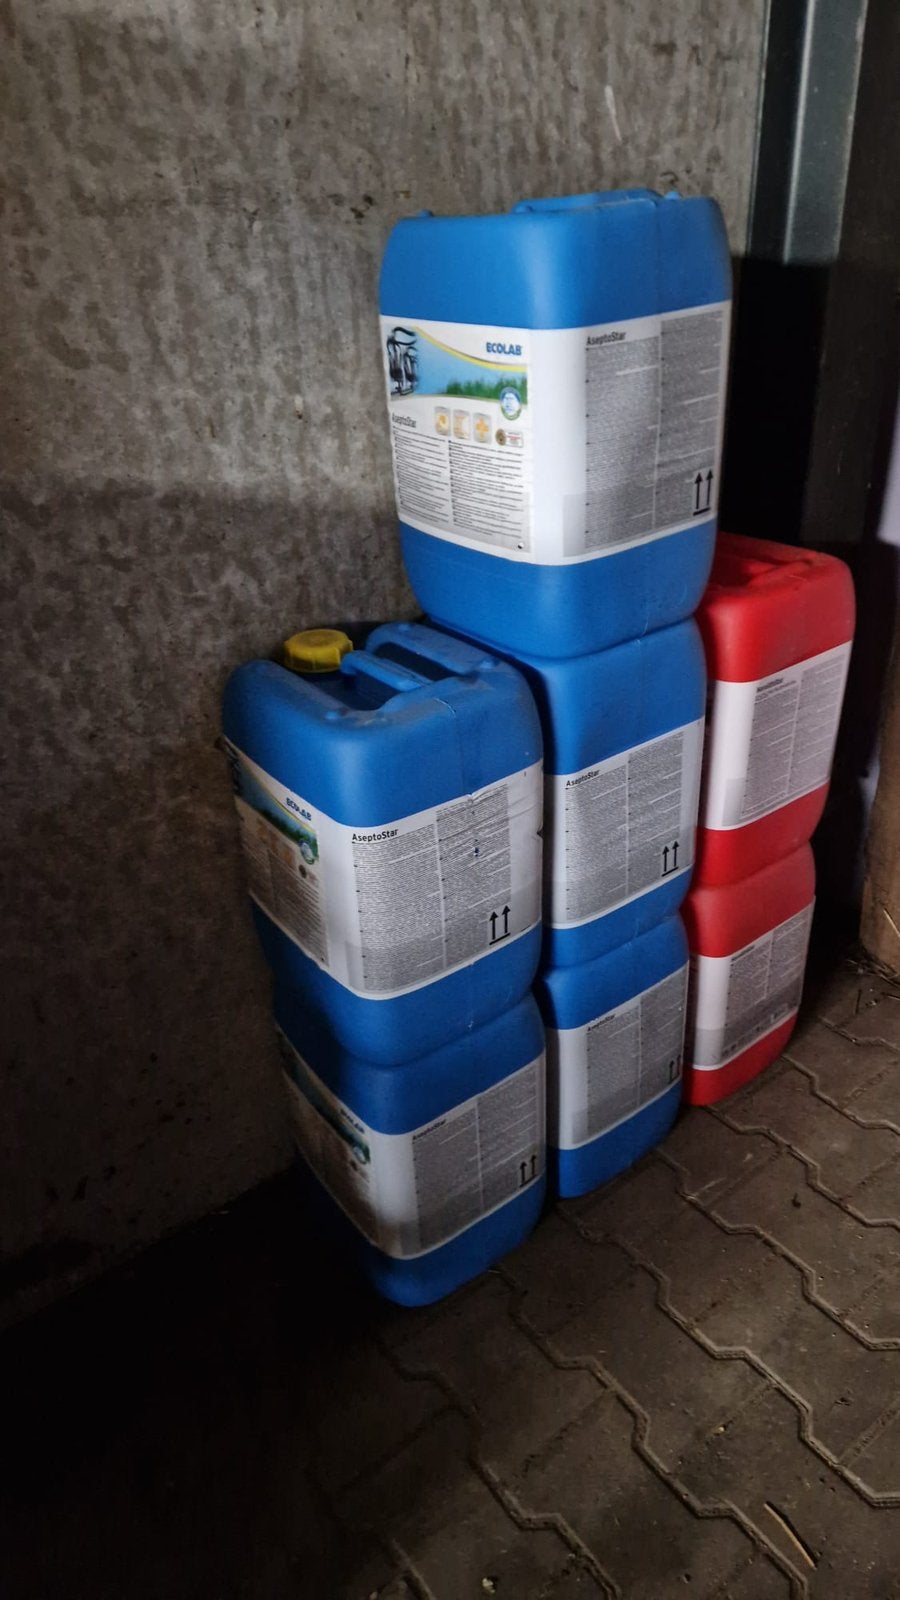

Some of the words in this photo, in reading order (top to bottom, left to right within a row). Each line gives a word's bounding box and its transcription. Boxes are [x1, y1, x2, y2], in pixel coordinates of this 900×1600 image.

[586, 331, 626, 346] AseptoStar
[486, 342, 522, 356] ECOLAB
[352, 829, 398, 842] AseptoStar
